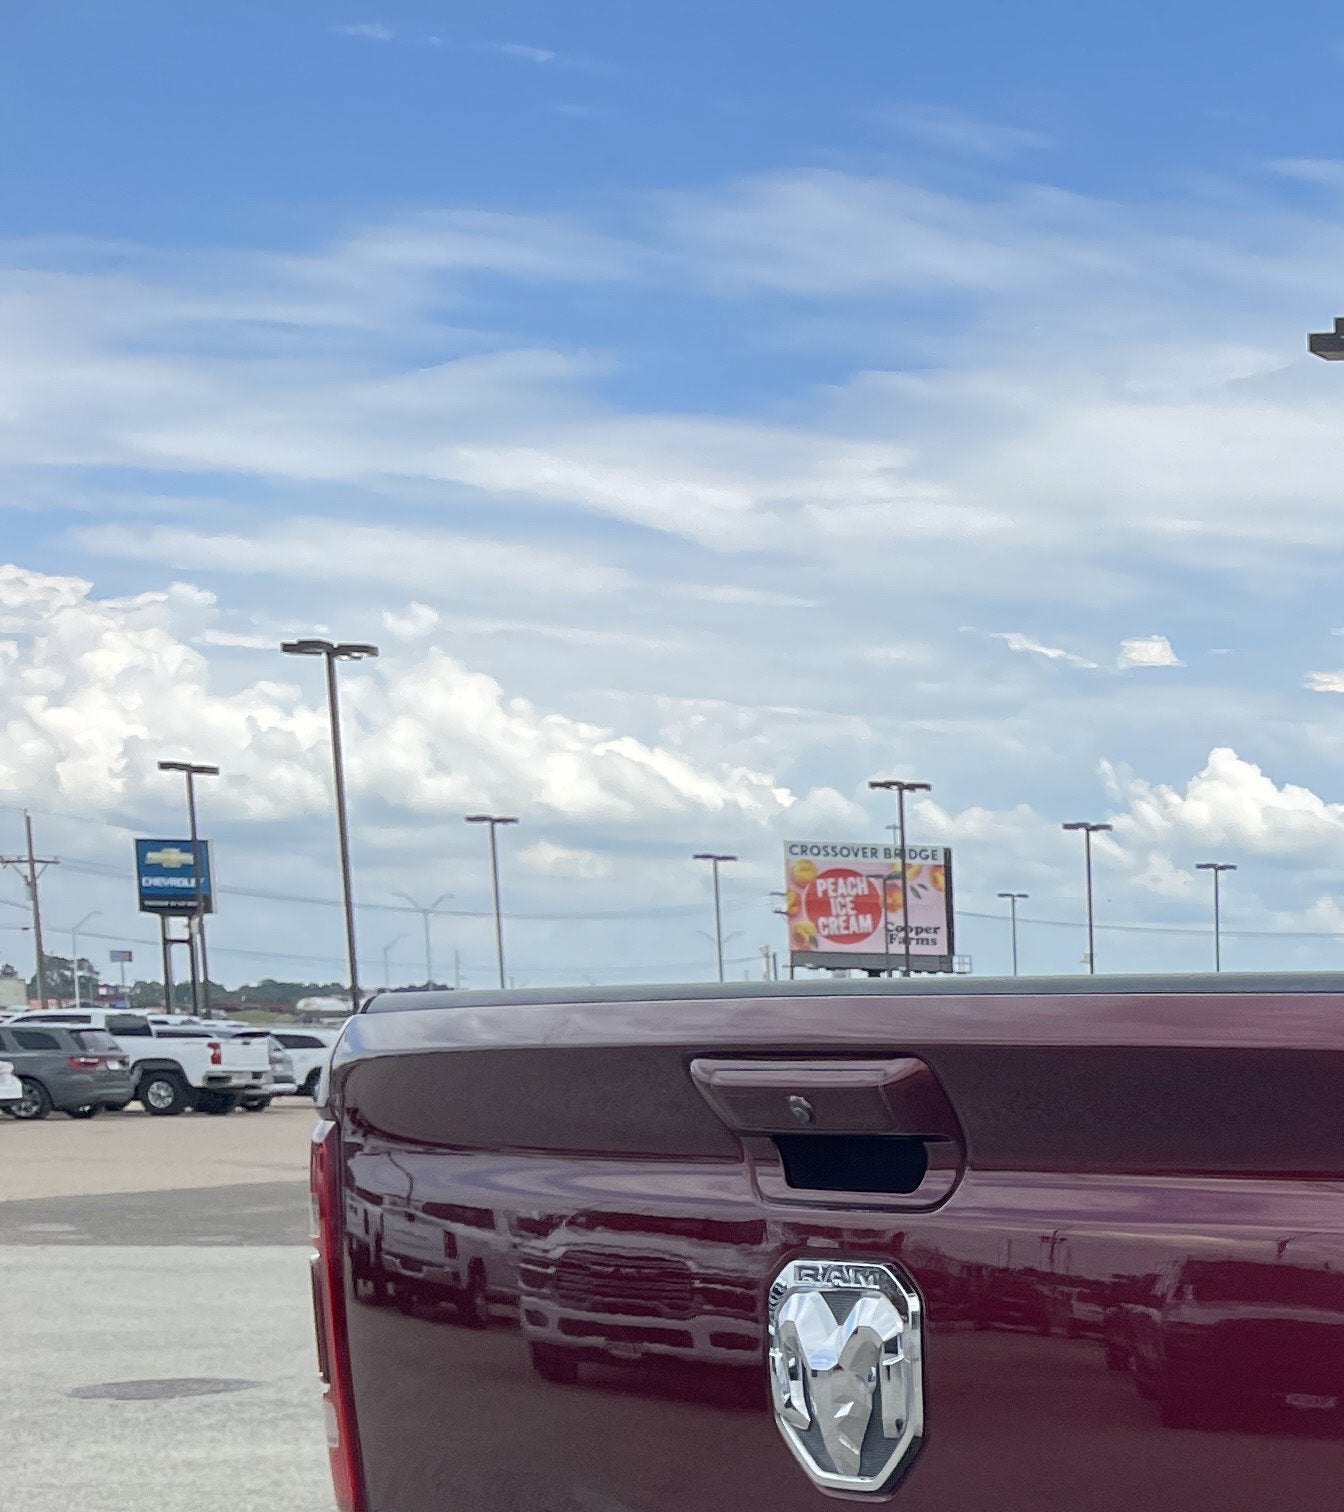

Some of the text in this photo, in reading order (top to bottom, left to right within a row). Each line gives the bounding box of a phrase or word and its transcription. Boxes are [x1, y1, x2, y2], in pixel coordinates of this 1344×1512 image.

[788, 844, 939, 861] CROSSOVER BRDGE
[816, 876, 869, 897] PEACH
[830, 897, 856, 915] ICE
[817, 914, 873, 936] CREAM
[793, 1264, 881, 1288] RAM
